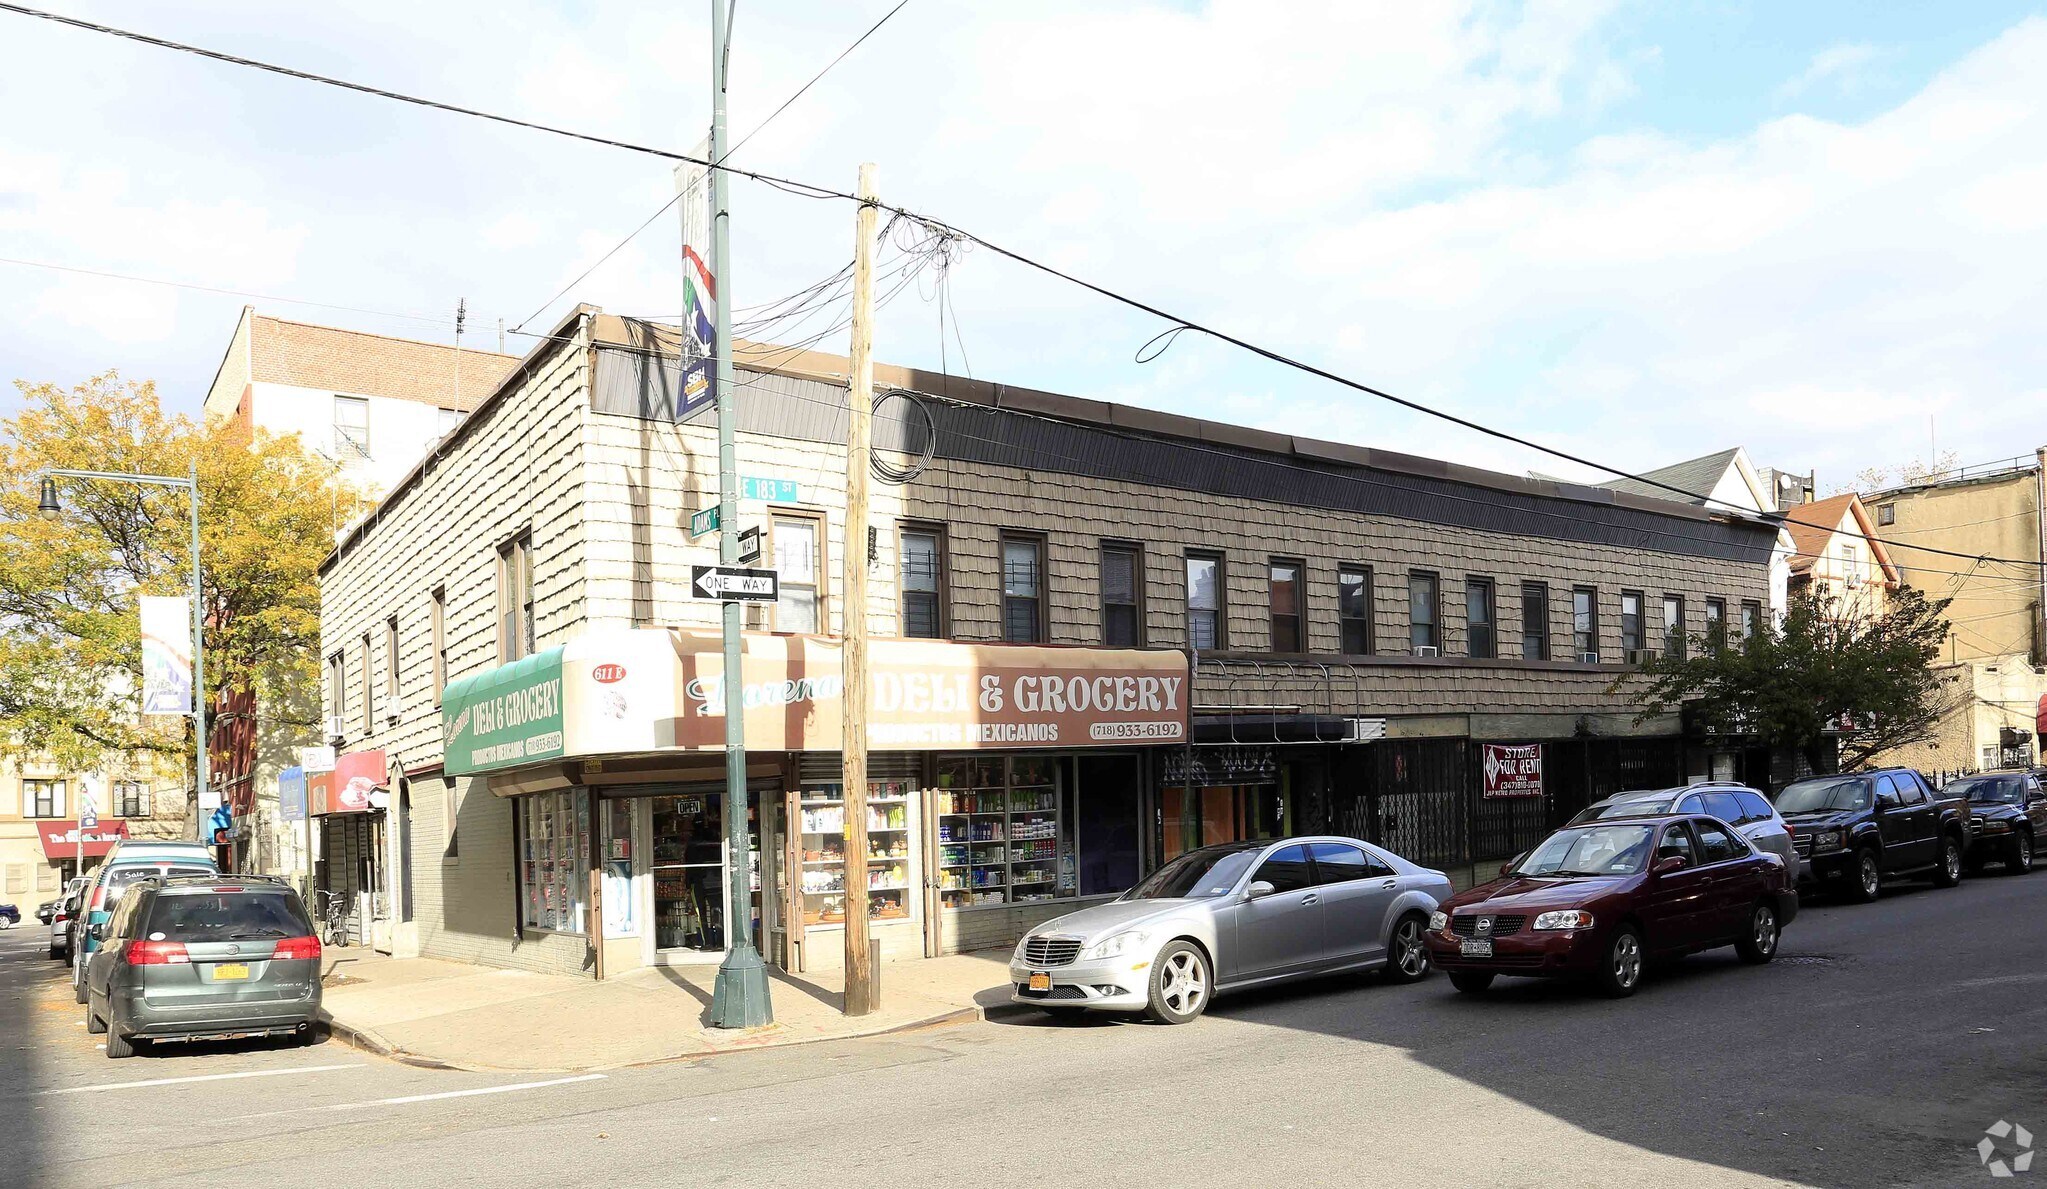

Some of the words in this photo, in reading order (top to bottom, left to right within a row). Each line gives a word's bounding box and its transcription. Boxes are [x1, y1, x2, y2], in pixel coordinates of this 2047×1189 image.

[743, 480, 750, 497] E
[756, 480, 776, 499] 183
[782, 482, 793, 492] ST
[694, 510, 711, 535] ADAMS
[742, 538, 755, 555] WAY
[705, 576, 730, 589] ONE
[743, 578, 767, 591] WAY
[594, 667, 614, 681] 611
[872, 671, 970, 713] DELI
[979, 674, 1003, 712] &
[1013, 675, 1182, 713] GROCERY
[473, 699, 496, 736] DELI
[497, 696, 504, 730] &
[505, 677, 560, 728] GROCERY
[966, 723, 1059, 742] MEXICANOS
[1504, 747, 1536, 759] STORE
[1500, 759, 1517, 775] FOR
[1519, 758, 1540, 774] RENT
[680, 802, 699, 814] OPEN
[125, 871, 145, 879] Sale
